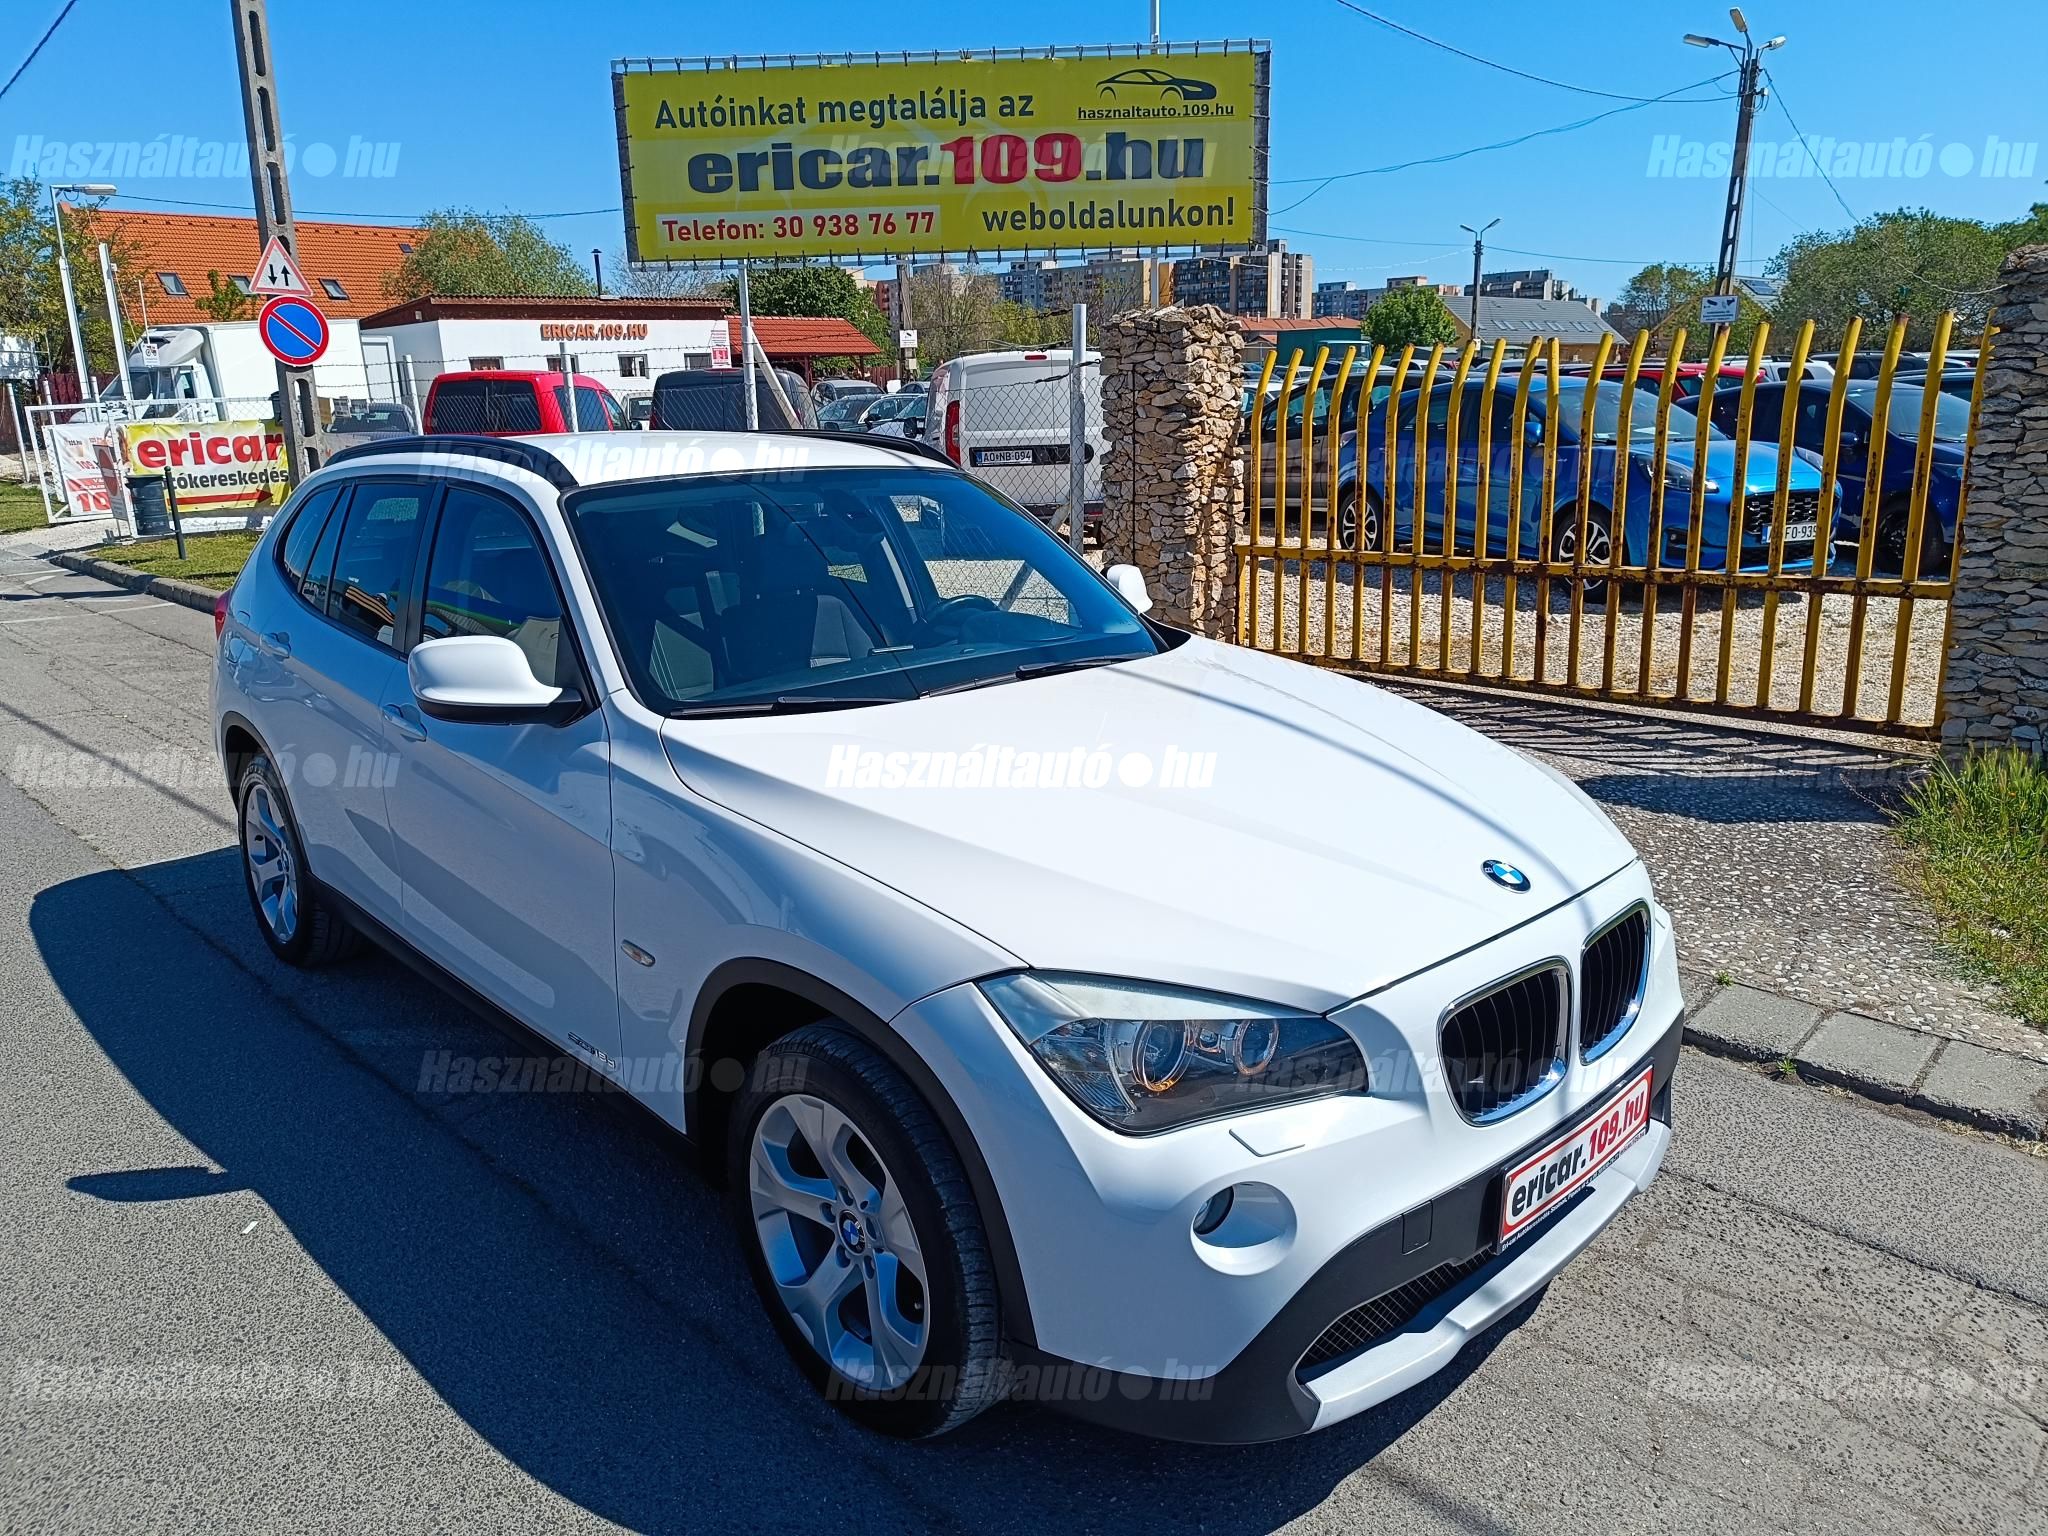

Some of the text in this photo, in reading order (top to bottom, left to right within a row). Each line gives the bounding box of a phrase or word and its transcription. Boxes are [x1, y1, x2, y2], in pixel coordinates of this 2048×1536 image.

[655, 86, 1034, 128] Autóinkat megtalálja az
[1077, 102, 1235, 120] hasznaltauto.109.hu
[687, 131, 1204, 194] ericar.109.hu
[662, 211, 934, 241] Telefon: 30 938 76 77
[982, 196, 1234, 232] weboldalunkon!
[541, 323, 648, 341] ERICAR.109.HU
[136, 431, 285, 468] ericar
